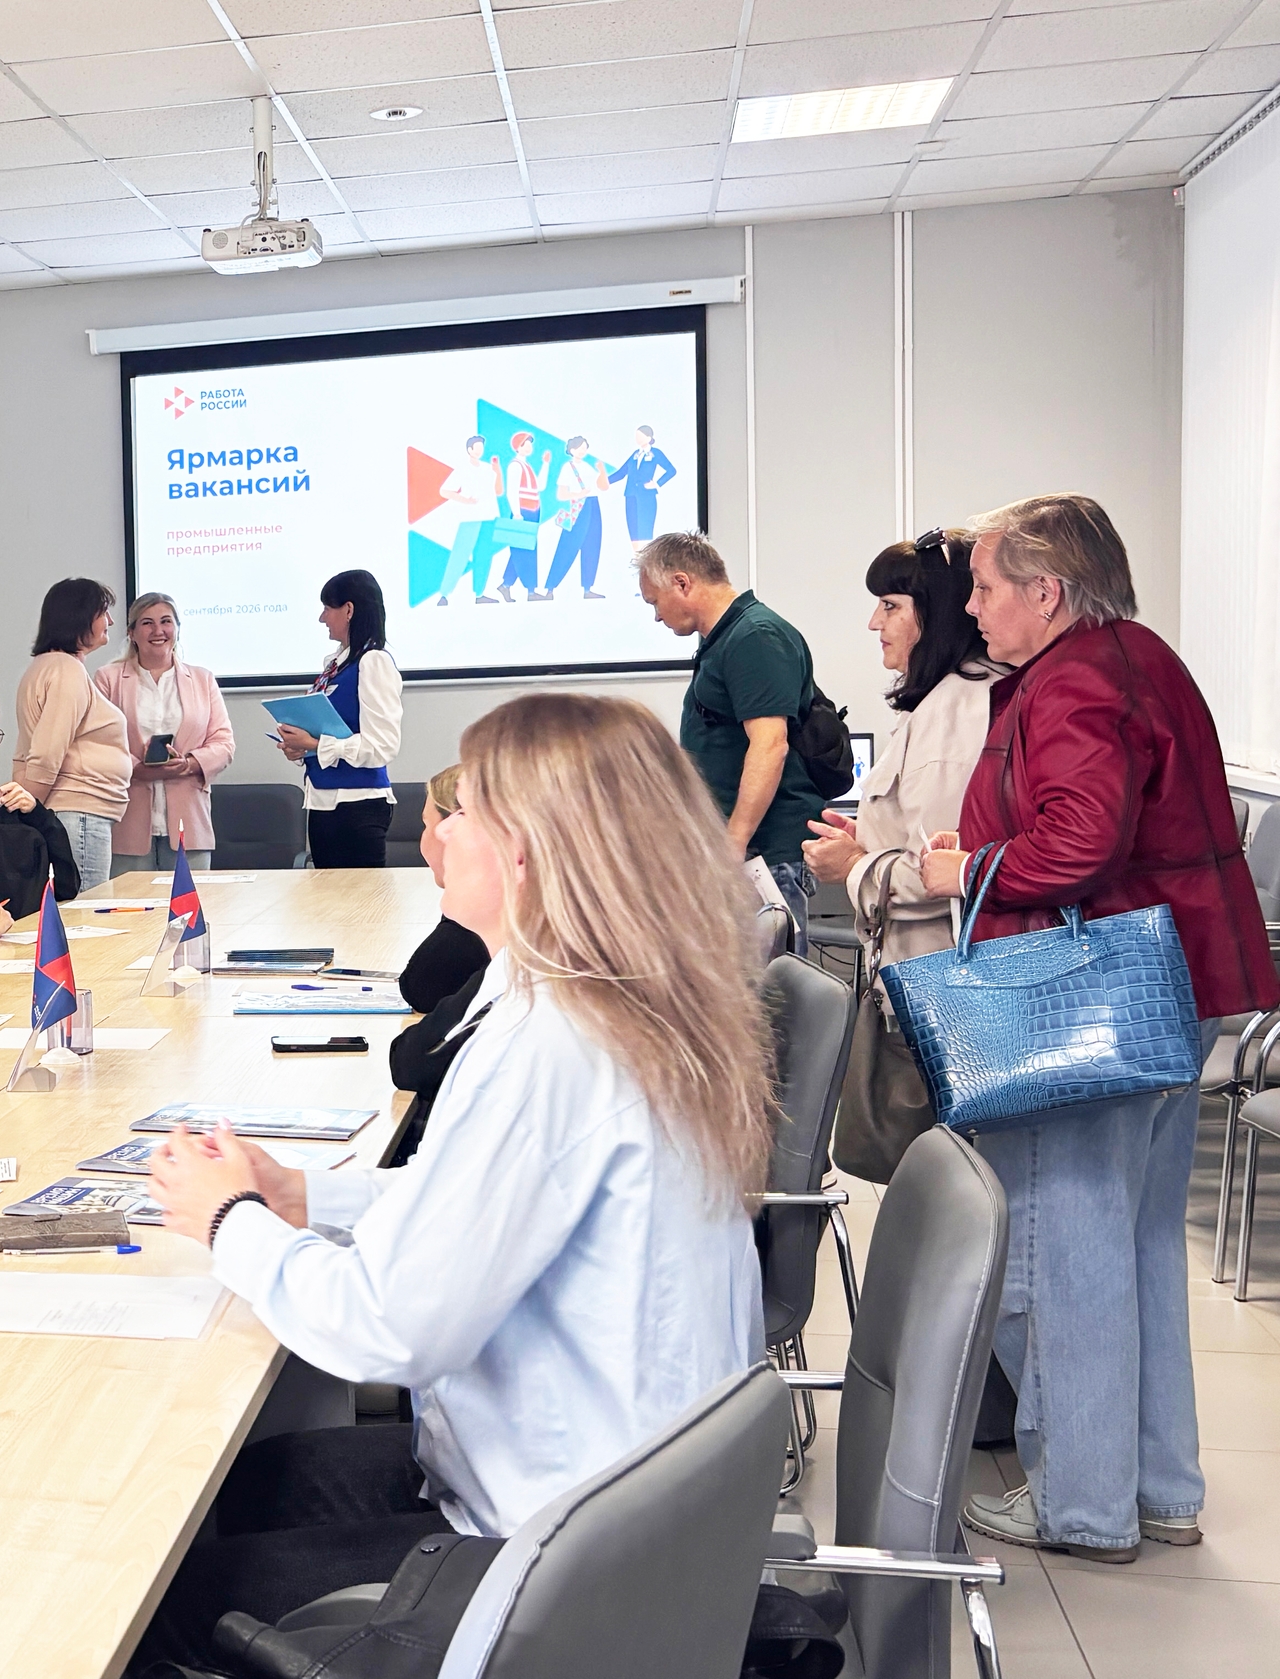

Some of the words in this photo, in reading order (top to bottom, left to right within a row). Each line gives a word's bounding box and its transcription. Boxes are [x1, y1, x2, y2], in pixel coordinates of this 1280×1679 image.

[200, 388, 245, 400] РАБОТА
[200, 399, 247, 411] РОССИИ
[167, 445, 299, 474] Ярмарка
[168, 468, 311, 500] вакансий
[166, 523, 283, 542] промышленные
[167, 541, 263, 558] предприятия
[183, 605, 233, 616] сентября
[235, 603, 261, 615] 2026
[263, 602, 288, 613] года
